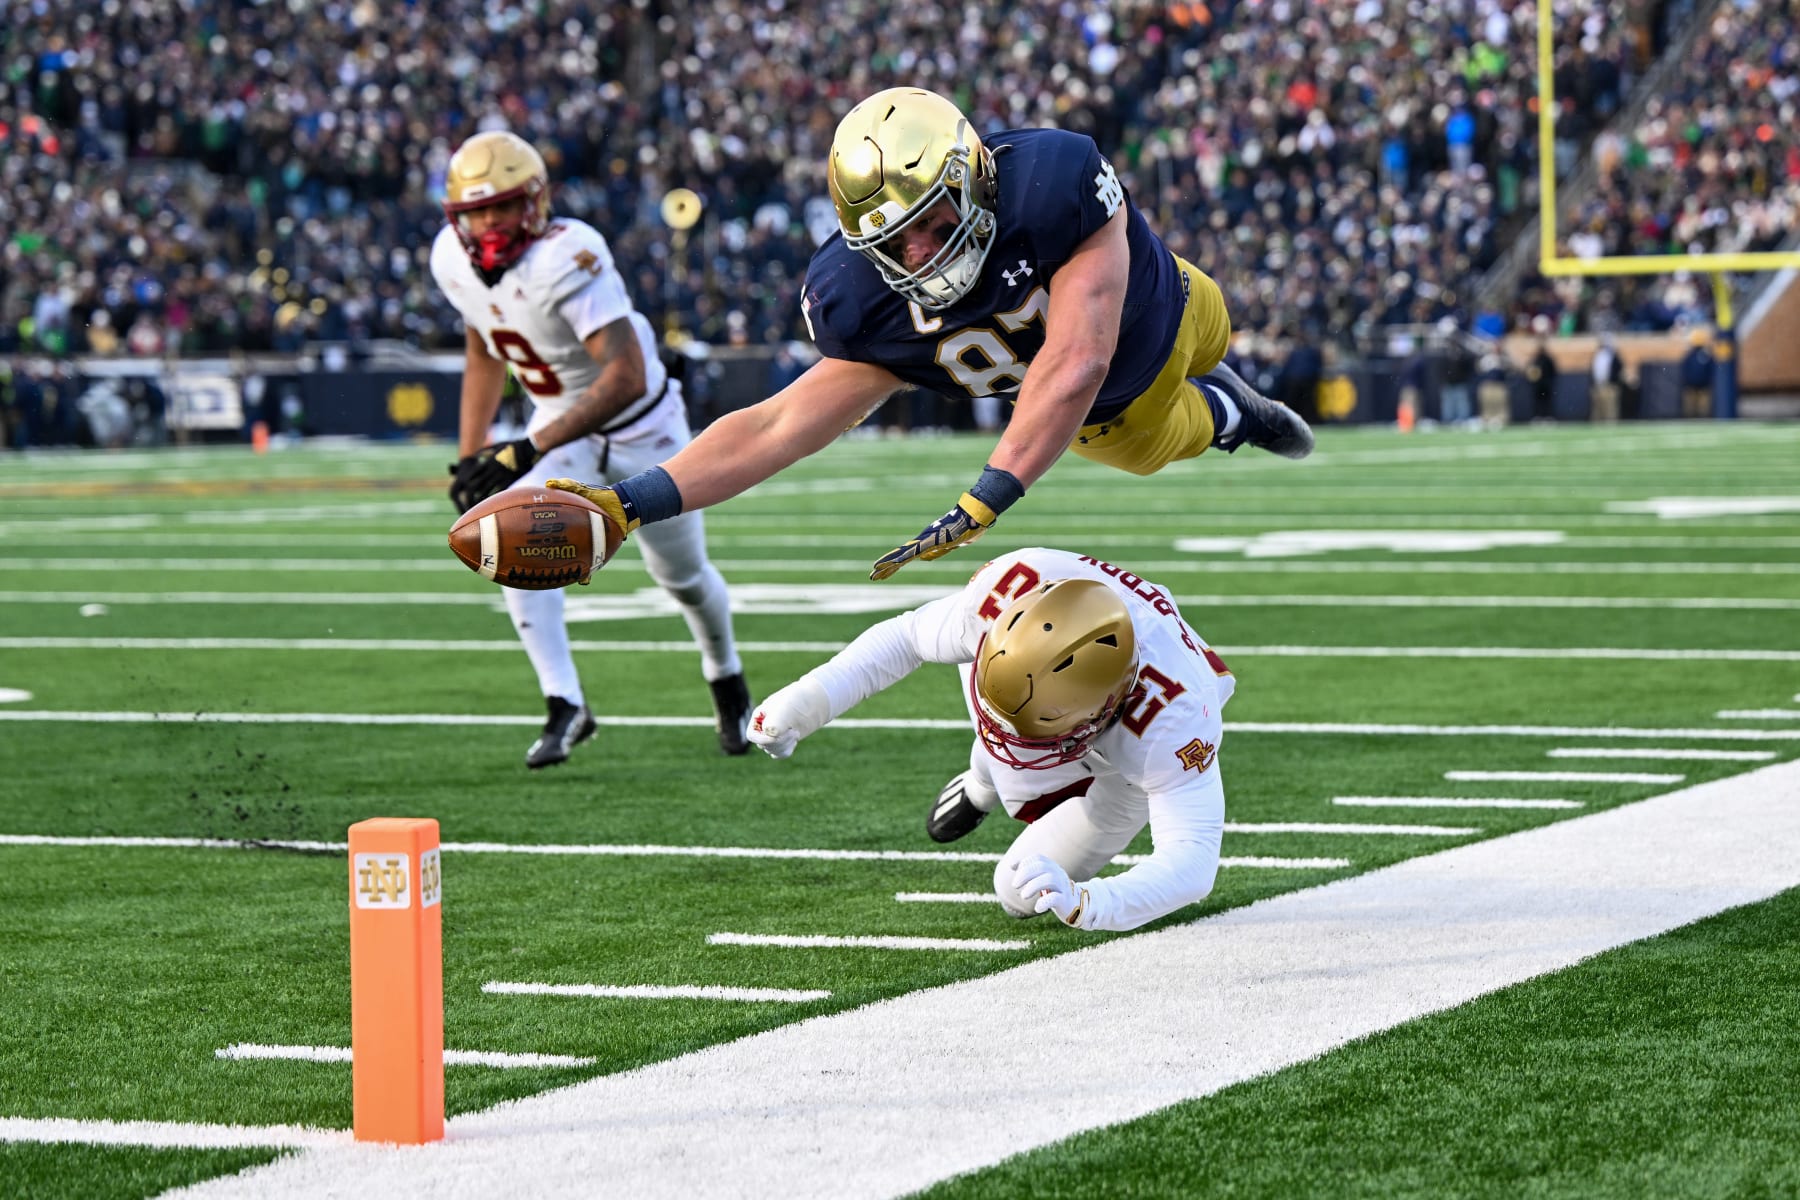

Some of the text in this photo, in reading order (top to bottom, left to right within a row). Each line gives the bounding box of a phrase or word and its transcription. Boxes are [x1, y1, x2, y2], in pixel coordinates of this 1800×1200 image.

[490, 328, 564, 398] 9
[534, 511, 557, 519] NCAA
[519, 544, 577, 560] Wilson
[1120, 663, 1187, 740] 21
